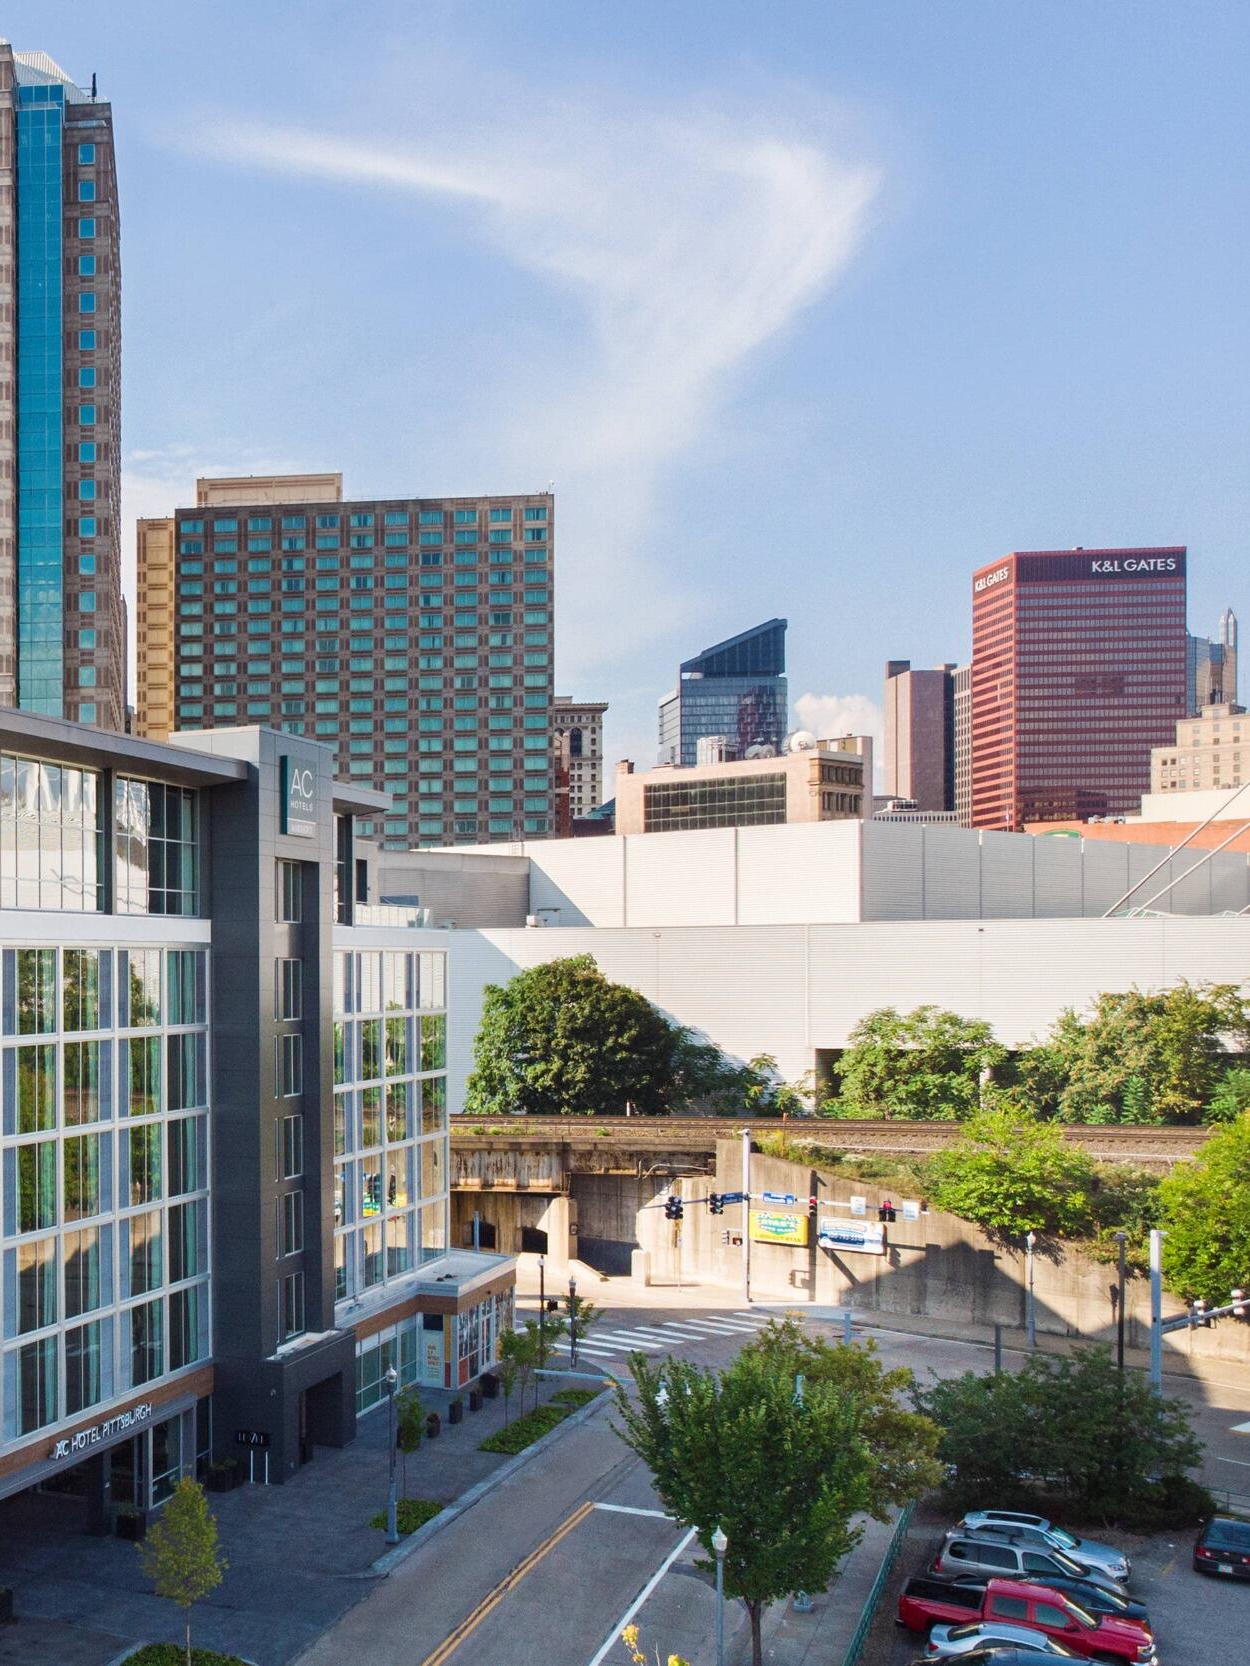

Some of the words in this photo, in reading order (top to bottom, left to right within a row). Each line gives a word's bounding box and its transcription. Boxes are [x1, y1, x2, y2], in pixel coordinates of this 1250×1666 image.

[1092, 560, 1121, 573] K&L
[1123, 558, 1176, 572] GATES
[974, 578, 987, 593] K&L
[987, 567, 1010, 587] GATES
[290, 768, 313, 798] AC
[290, 800, 313, 812] HOTELS
[55, 1440, 69, 1459] AC
[71, 1426, 101, 1452] HOTEL
[102, 1402, 152, 1438] PITTSBURGH
